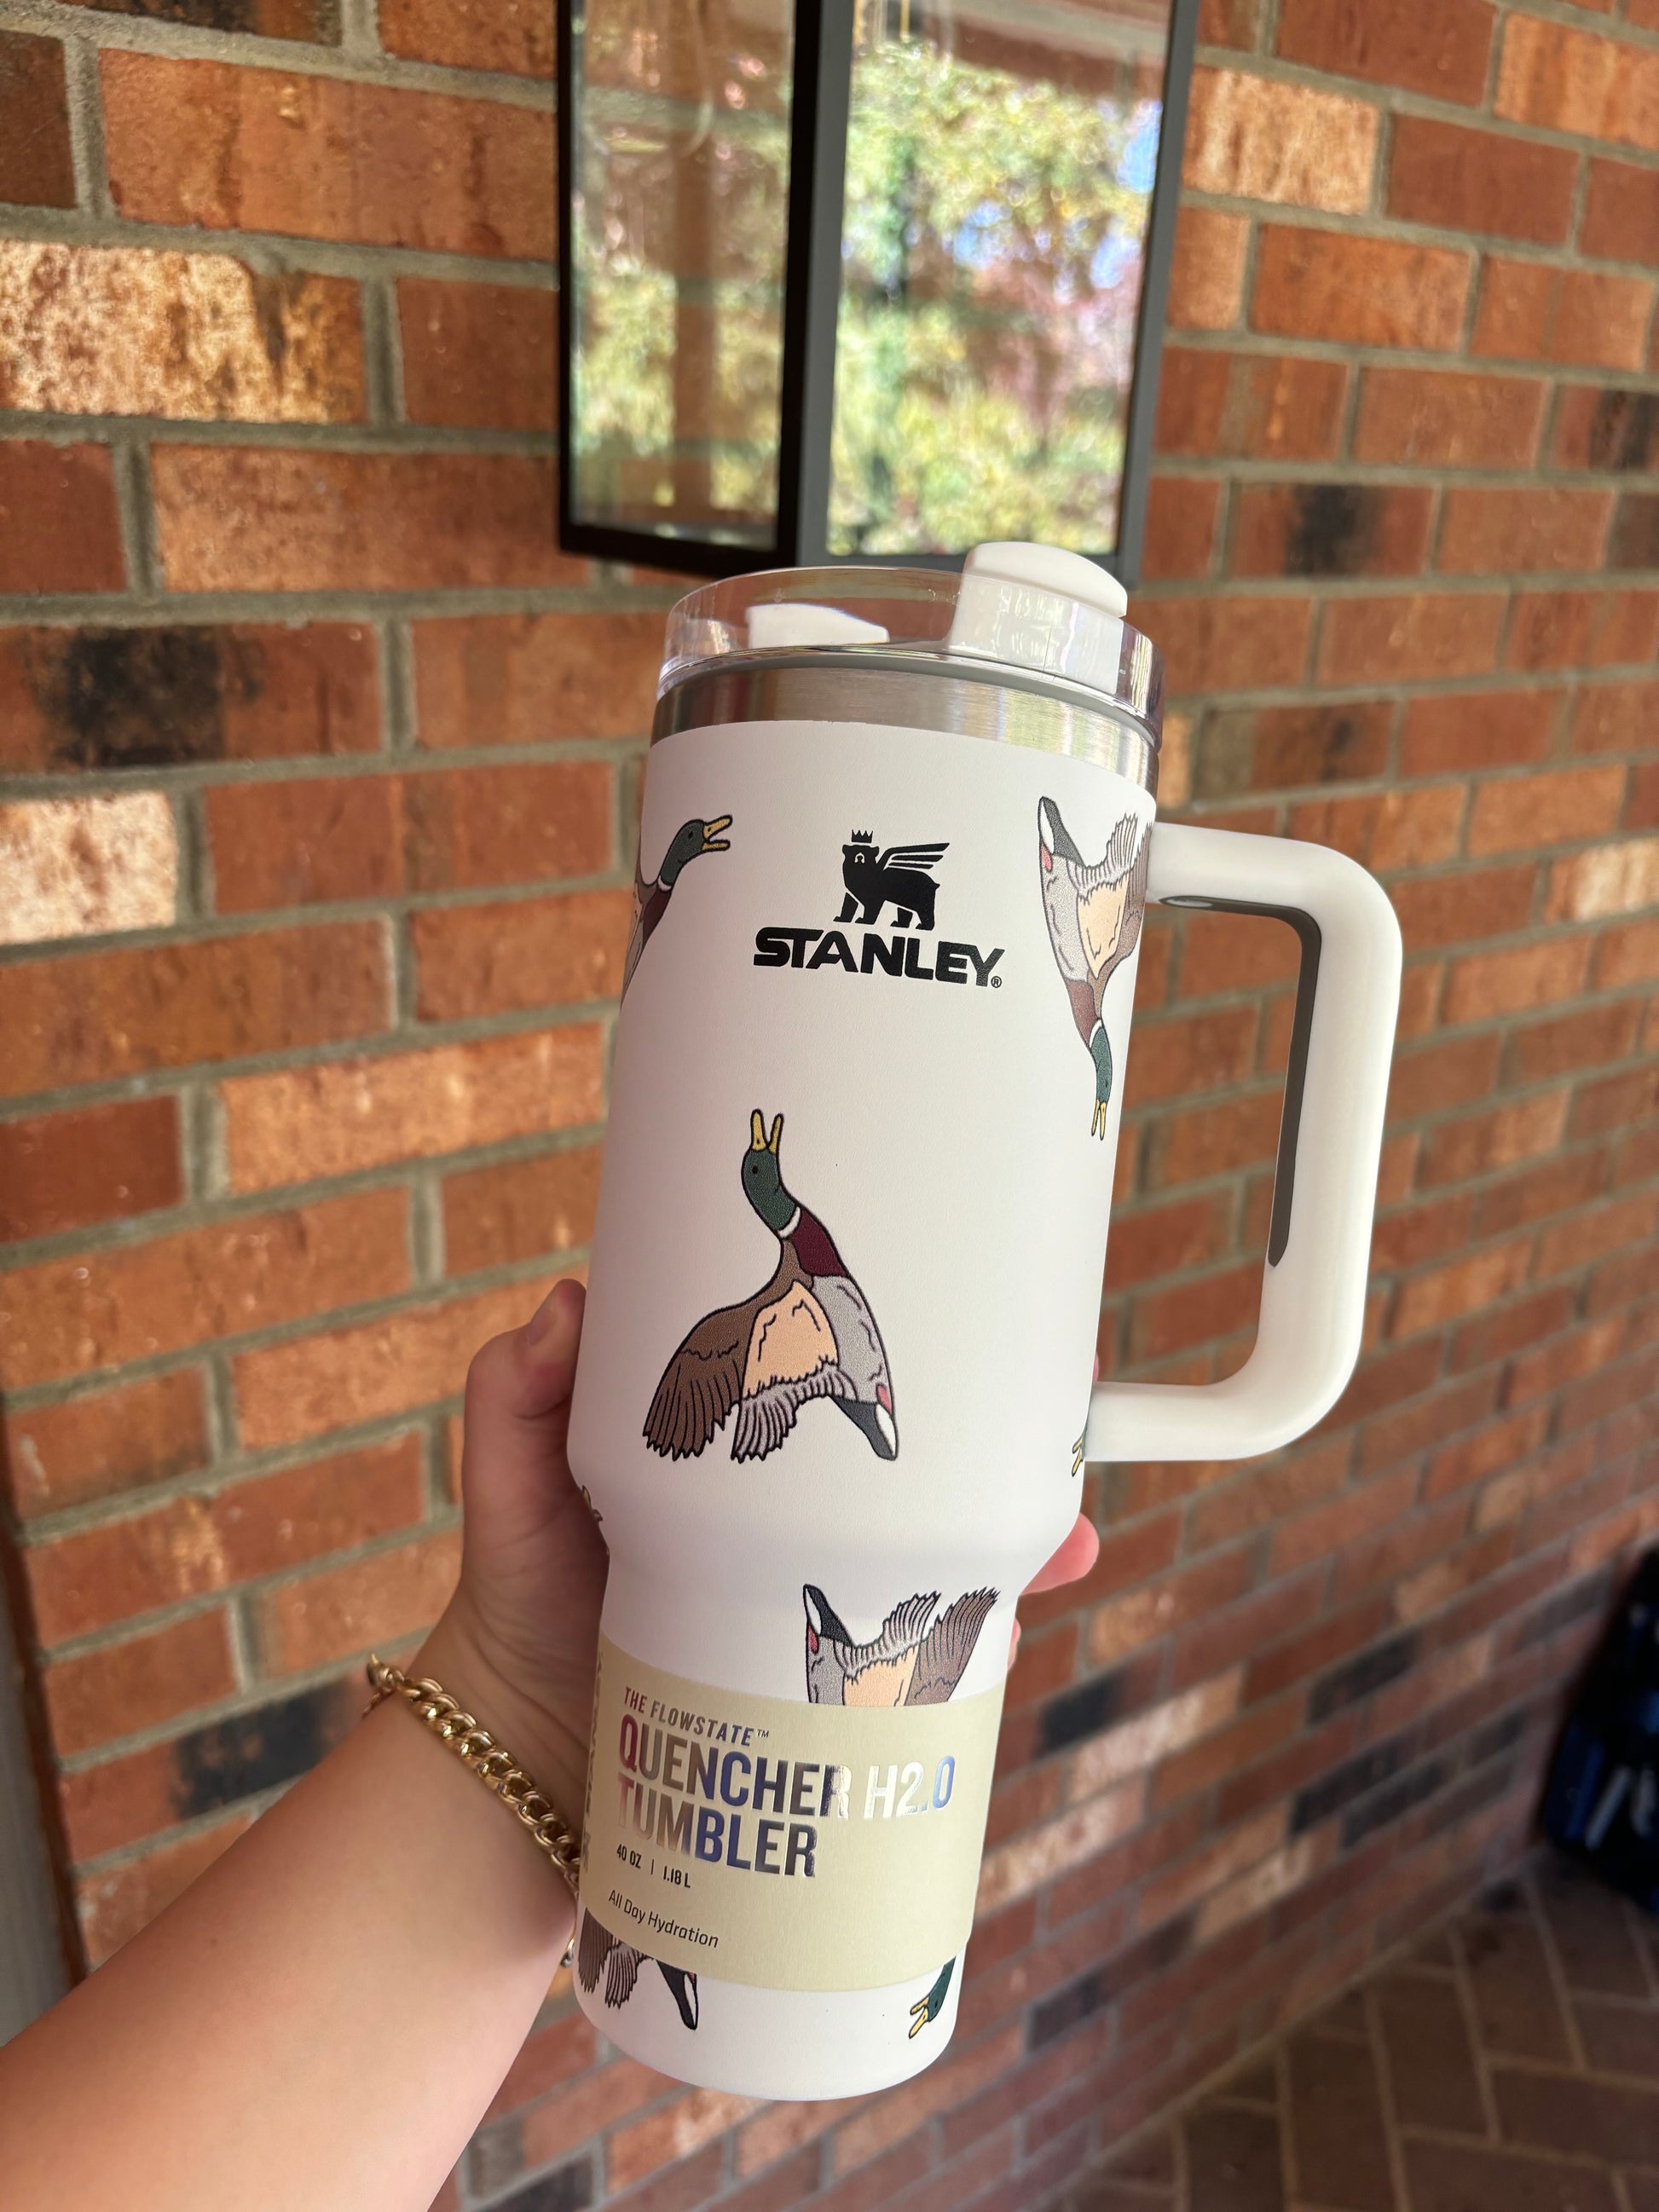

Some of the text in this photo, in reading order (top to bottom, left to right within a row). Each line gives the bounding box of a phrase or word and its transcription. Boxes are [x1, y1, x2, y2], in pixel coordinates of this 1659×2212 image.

[624, 1686, 647, 1713] THE
[619, 1713, 956, 1819] QUENCHER H2.0
[617, 1771, 818, 1878] TUMBLER
[616, 1843, 627, 1862] 40
[629, 1851, 642, 1868] OZ
[663, 1865, 682, 1886] 1.18
[684, 1872, 691, 1888] L
[609, 1889, 720, 1949] All Day Hydration
